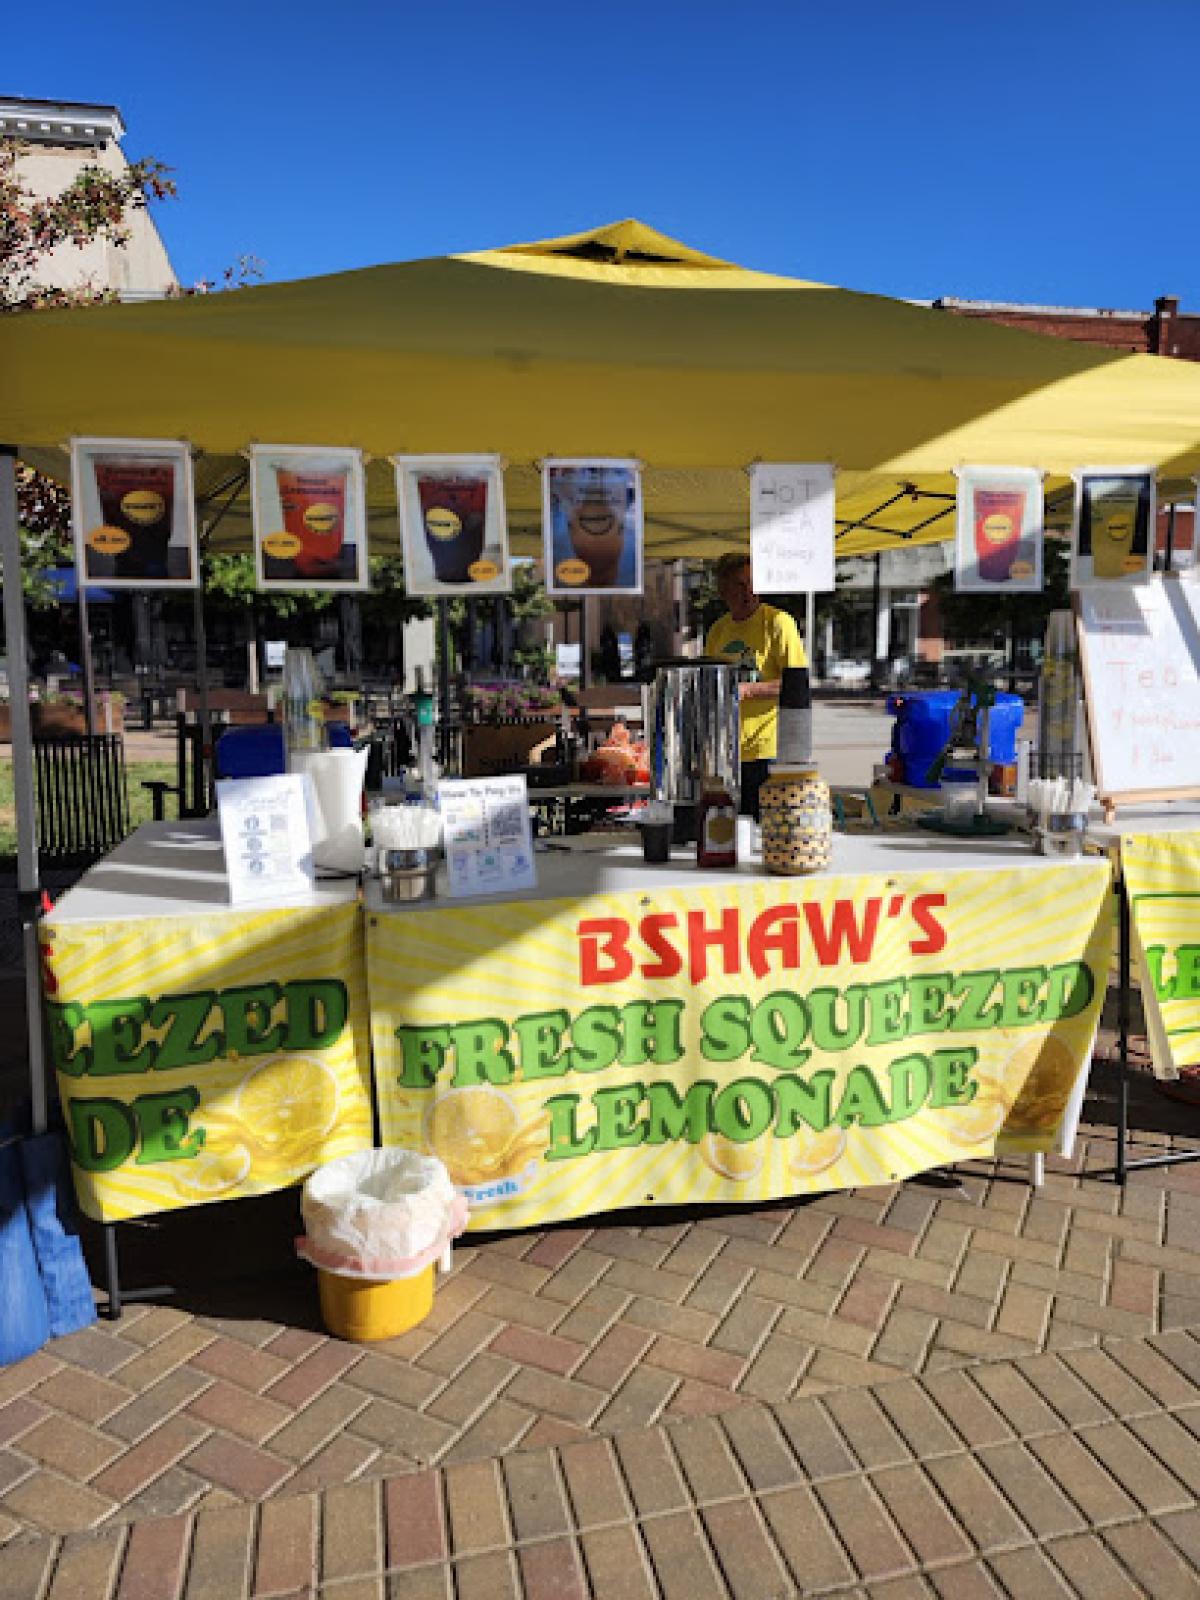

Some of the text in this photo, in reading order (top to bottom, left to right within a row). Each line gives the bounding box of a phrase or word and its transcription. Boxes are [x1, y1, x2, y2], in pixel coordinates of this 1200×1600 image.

[578, 893, 947, 986] BSHAW'S
[395, 960, 1095, 1089] FRESH SQUEEZED
[70, 1084, 206, 1172] DE
[545, 1046, 979, 1161] LEMONADE
